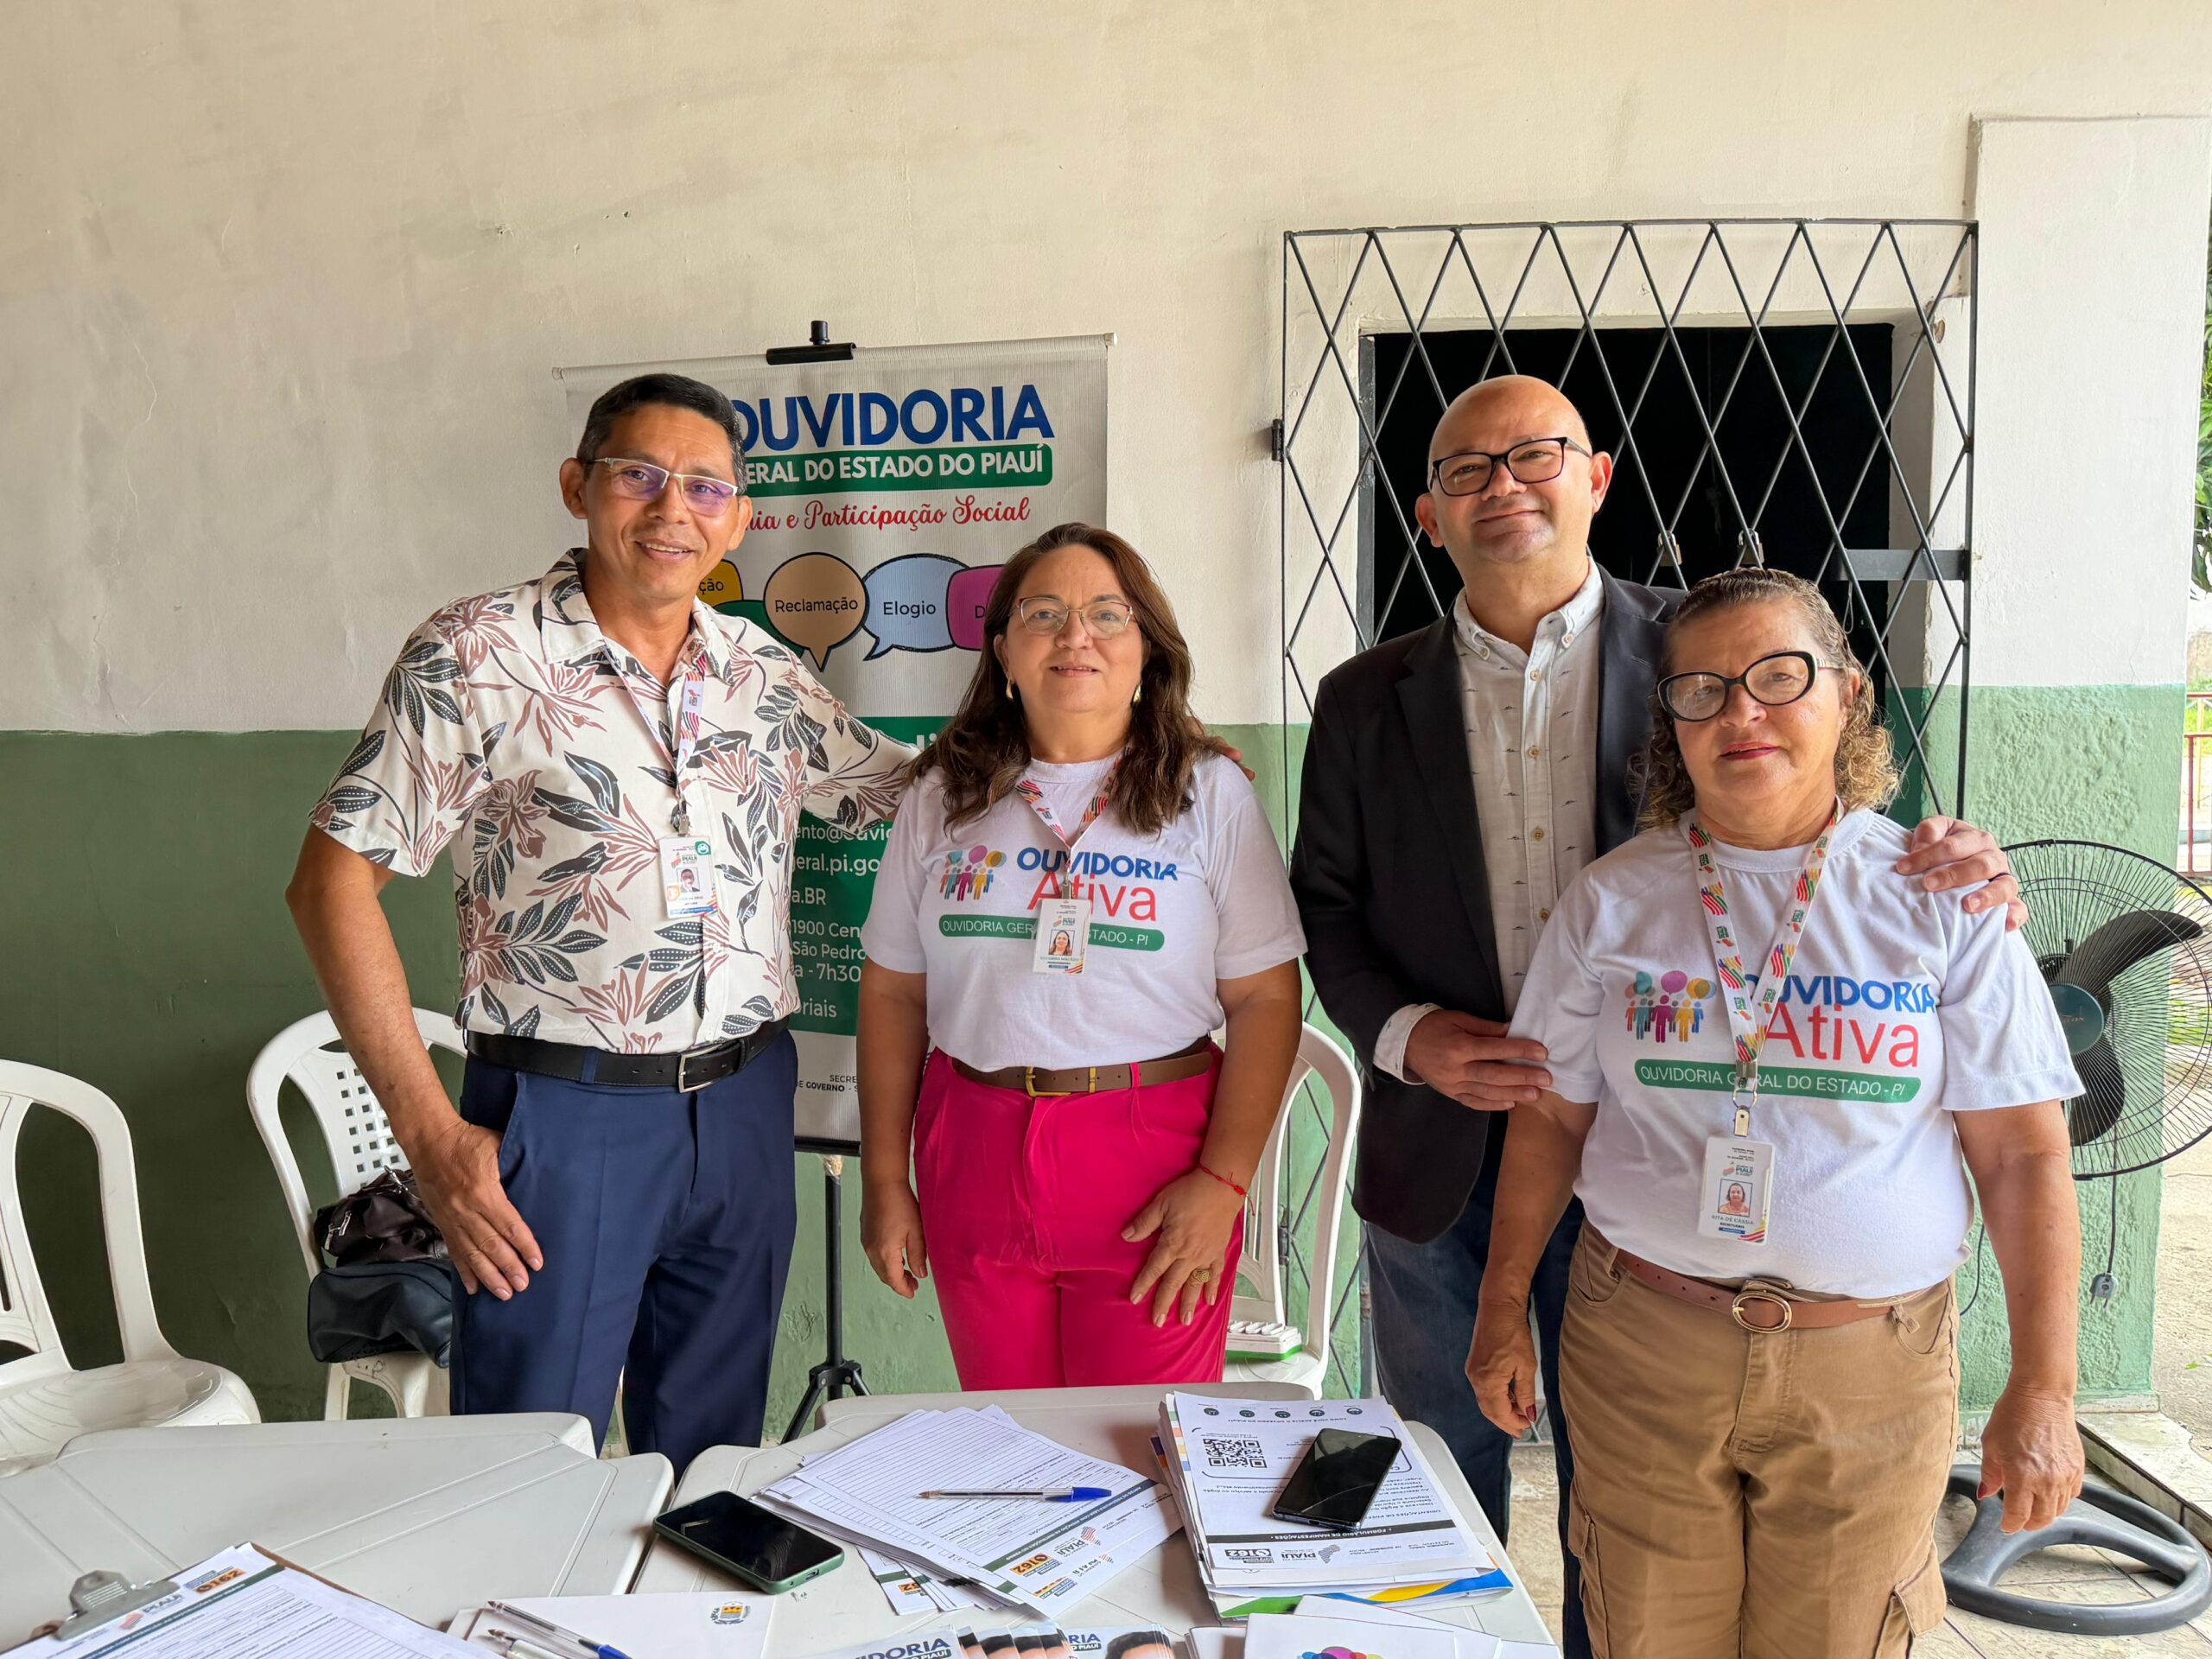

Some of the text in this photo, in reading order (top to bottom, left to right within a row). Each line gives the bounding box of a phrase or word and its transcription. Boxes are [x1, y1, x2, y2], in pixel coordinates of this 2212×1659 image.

[747, 443, 1043, 484] ERAL DO ESTADO DO PIAUÍ
[786, 514, 798, 528] e
[804, 500, 947, 531] Participação
[952, 495, 1030, 524] Social
[698, 579, 724, 594] ção
[775, 597, 858, 614] Reclamação
[883, 601, 937, 618] Elogio
[1017, 847, 1178, 880] OUVIDORIA
[828, 922, 863, 938] Cen
[943, 920, 1003, 932] OUVIDORIA
[1136, 935, 1148, 945] PI
[792, 941, 868, 960] São Pedro
[817, 963, 861, 982] 7h30
[1765, 1002, 1919, 1068] Ativa
[806, 1081, 845, 1092] GOVERNO
[830, 1074, 857, 1084] SECRE
[1641, 1065, 1722, 1084] OUVIDORIA
[1787, 1075, 1811, 1090] DO
[1816, 1077, 1881, 1095] ESTADO
[1891, 1082, 1906, 1096] PI
[1068, 1633, 1101, 1643] RIA
